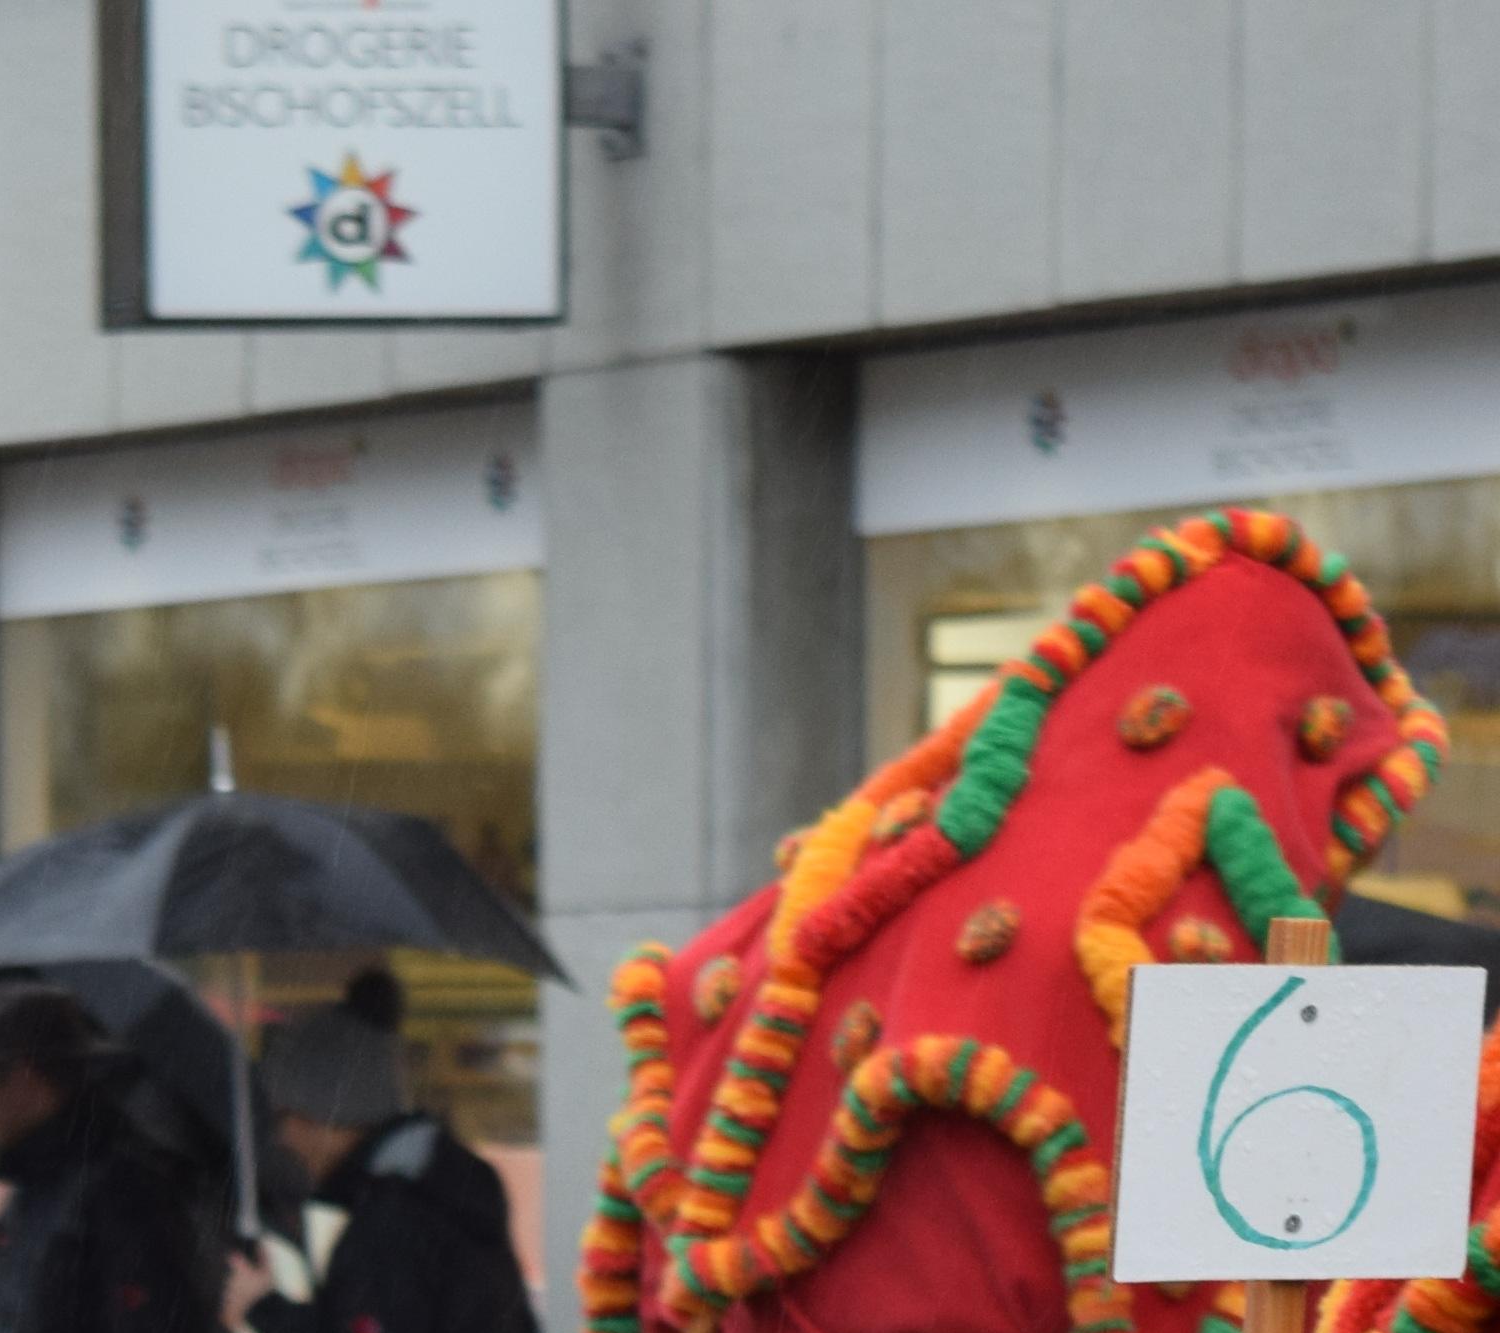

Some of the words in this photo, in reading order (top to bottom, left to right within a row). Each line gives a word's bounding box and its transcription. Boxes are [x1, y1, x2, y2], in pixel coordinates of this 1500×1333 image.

[222, 22, 479, 70] DROGERIE
[179, 83, 523, 129] BISCHOFSZELL
[1197, 976, 1379, 1250] 6
